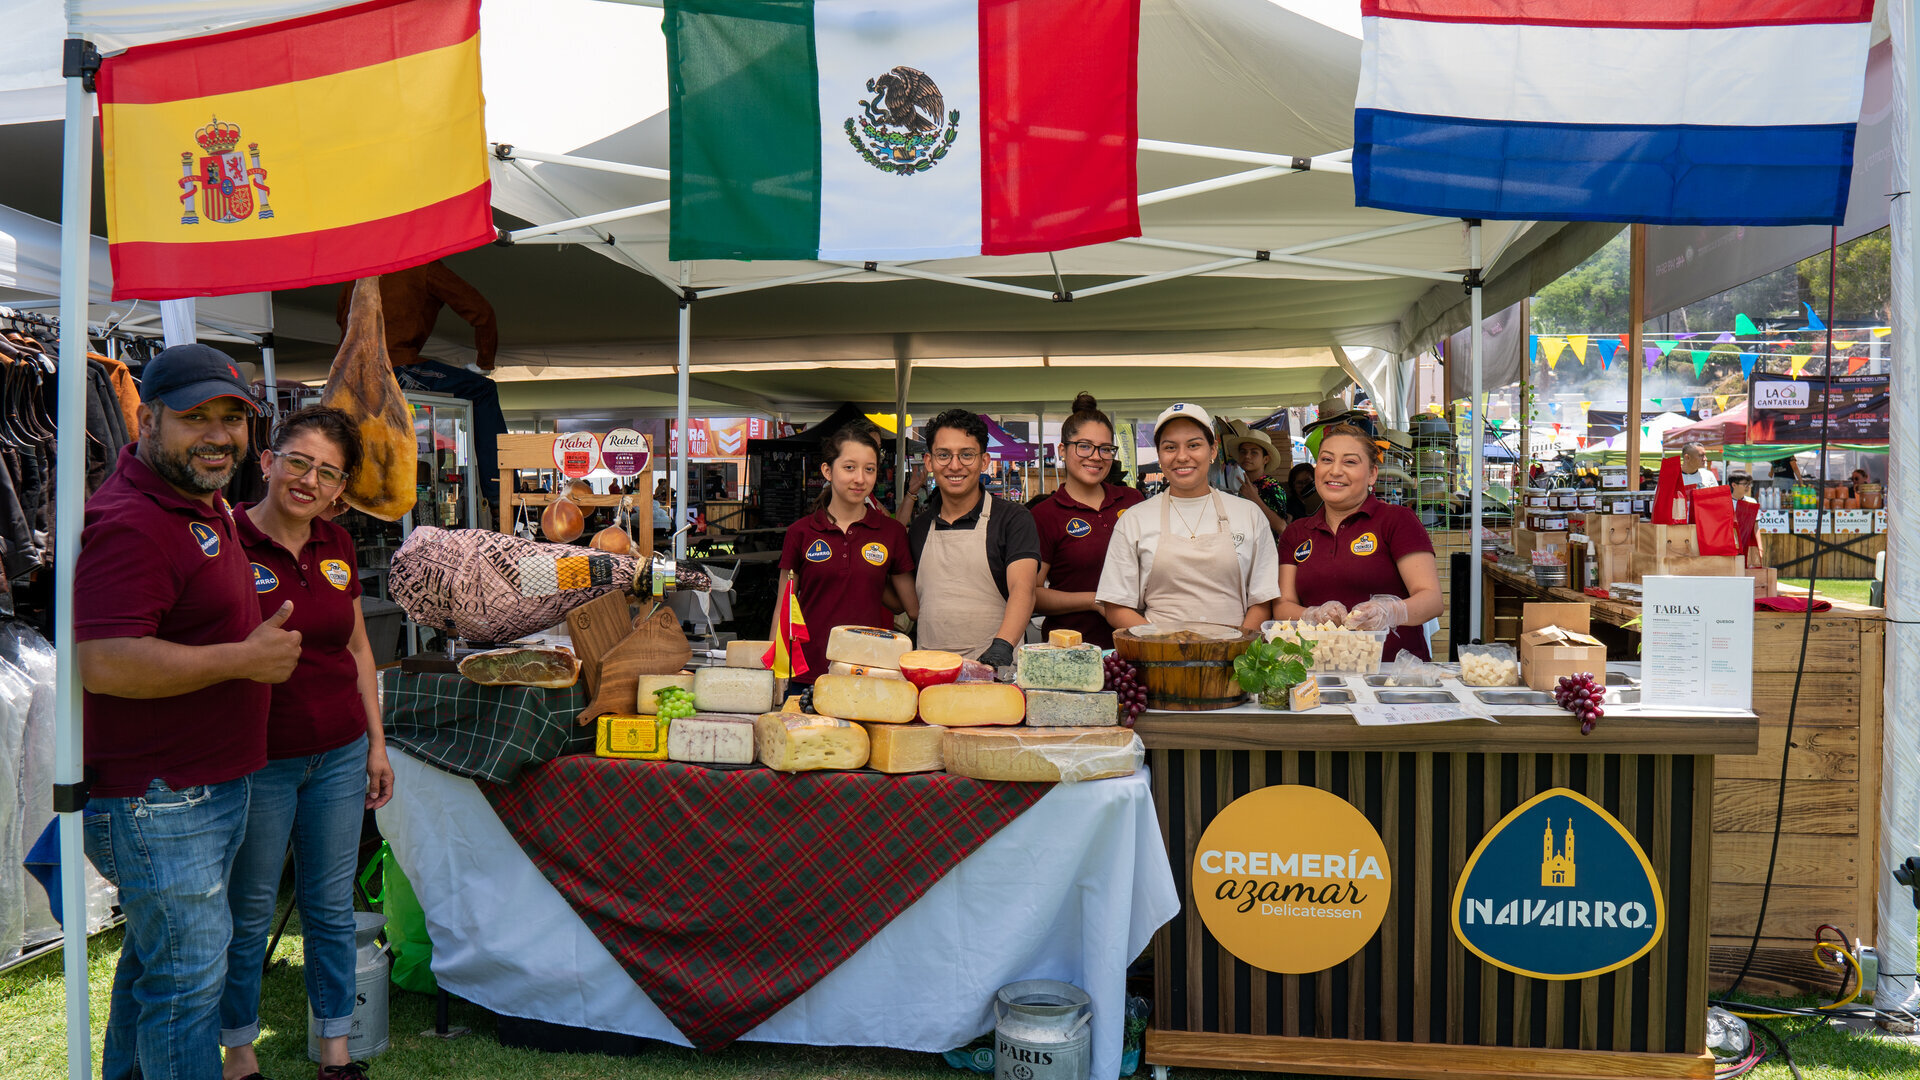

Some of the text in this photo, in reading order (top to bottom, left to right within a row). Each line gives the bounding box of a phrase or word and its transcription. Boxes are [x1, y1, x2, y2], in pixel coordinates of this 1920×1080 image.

[1766, 388, 1778, 398] LA
[610, 434, 640, 447] Rabel
[1652, 604, 1700, 615] TABLAS
[1200, 849, 1384, 880] CREMERÍA
[1215, 879, 1368, 914] azamar
[1262, 904, 1362, 919] Delicatessen
[1466, 898, 1647, 928] NAVARRO
[1000, 1040, 1053, 1066] PARIS
